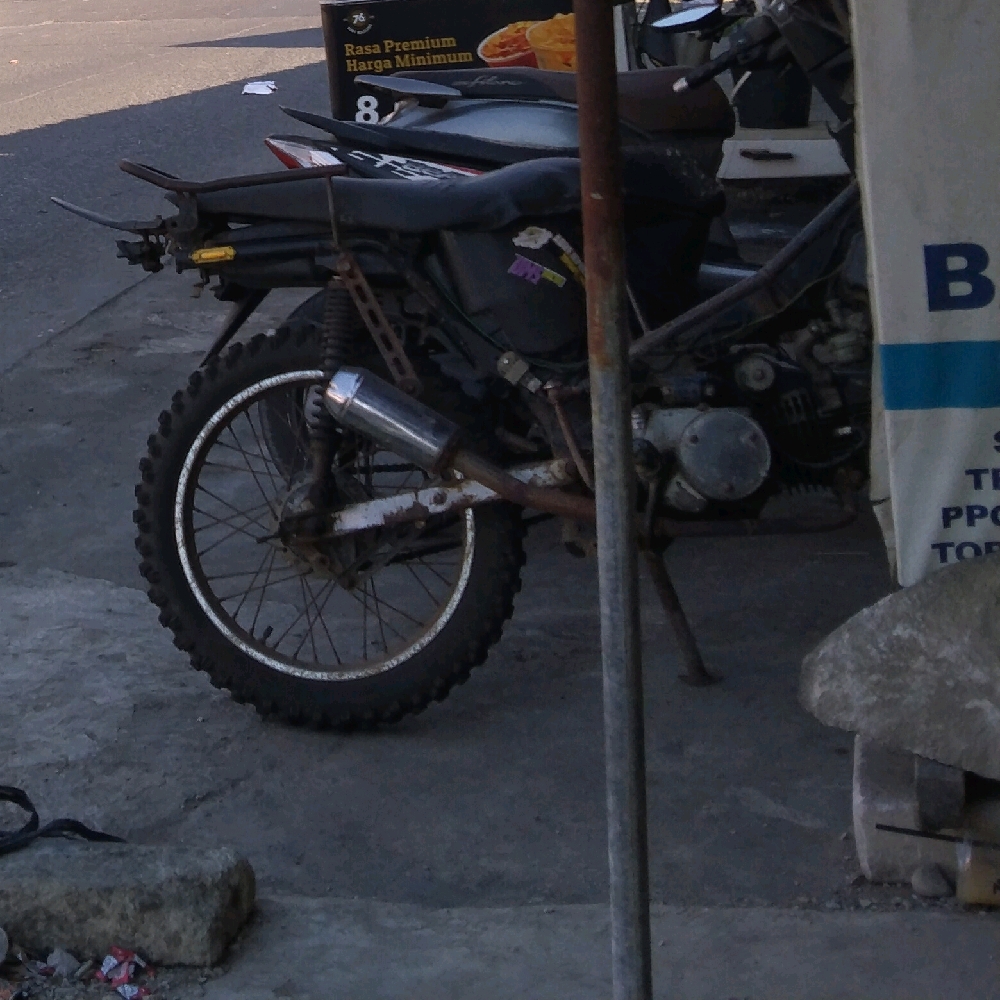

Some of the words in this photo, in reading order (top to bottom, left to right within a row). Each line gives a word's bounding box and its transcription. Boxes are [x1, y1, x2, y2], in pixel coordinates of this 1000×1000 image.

[344, 43, 382, 57] Rasa
[383, 36, 457, 52] Premium
[346, 58, 393, 73] Harga
[395, 51, 473, 68] Minimum
